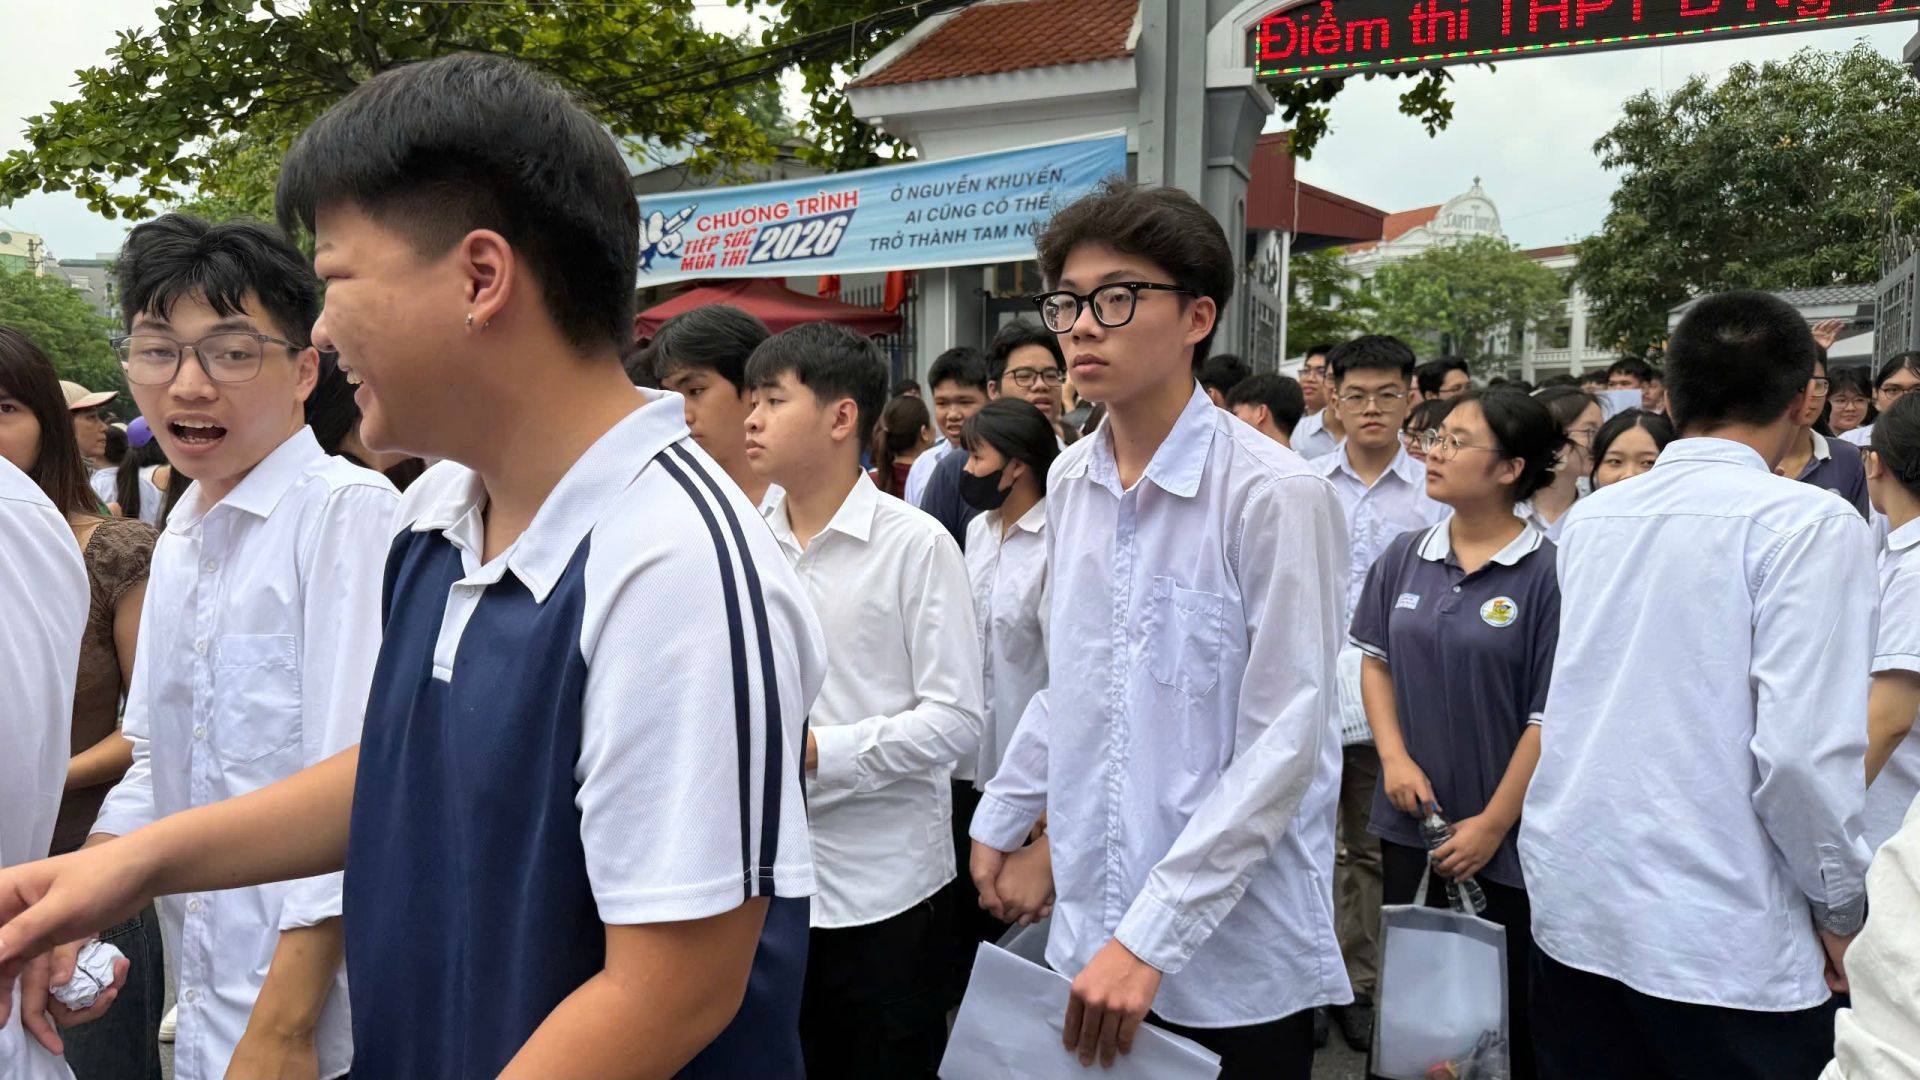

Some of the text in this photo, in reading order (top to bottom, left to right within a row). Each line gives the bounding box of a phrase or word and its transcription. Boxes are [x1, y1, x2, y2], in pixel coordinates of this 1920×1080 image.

[1261, 1, 1389, 60] Điểm
[1408, 0, 1469, 44] thi
[907, 174, 981, 200] NGUYỄN
[696, 190, 859, 232] CHƯƠNG TRÌNH
[905, 209, 922, 225] AI
[927, 203, 977, 222] CŨNG
[983, 196, 1009, 216] CÓ
[751, 215, 848, 263] 2026
[869, 232, 904, 251] TRỞ
[909, 226, 967, 248] THÀNH
[973, 224, 1008, 242] TAM
[721, 249, 750, 268] THI
